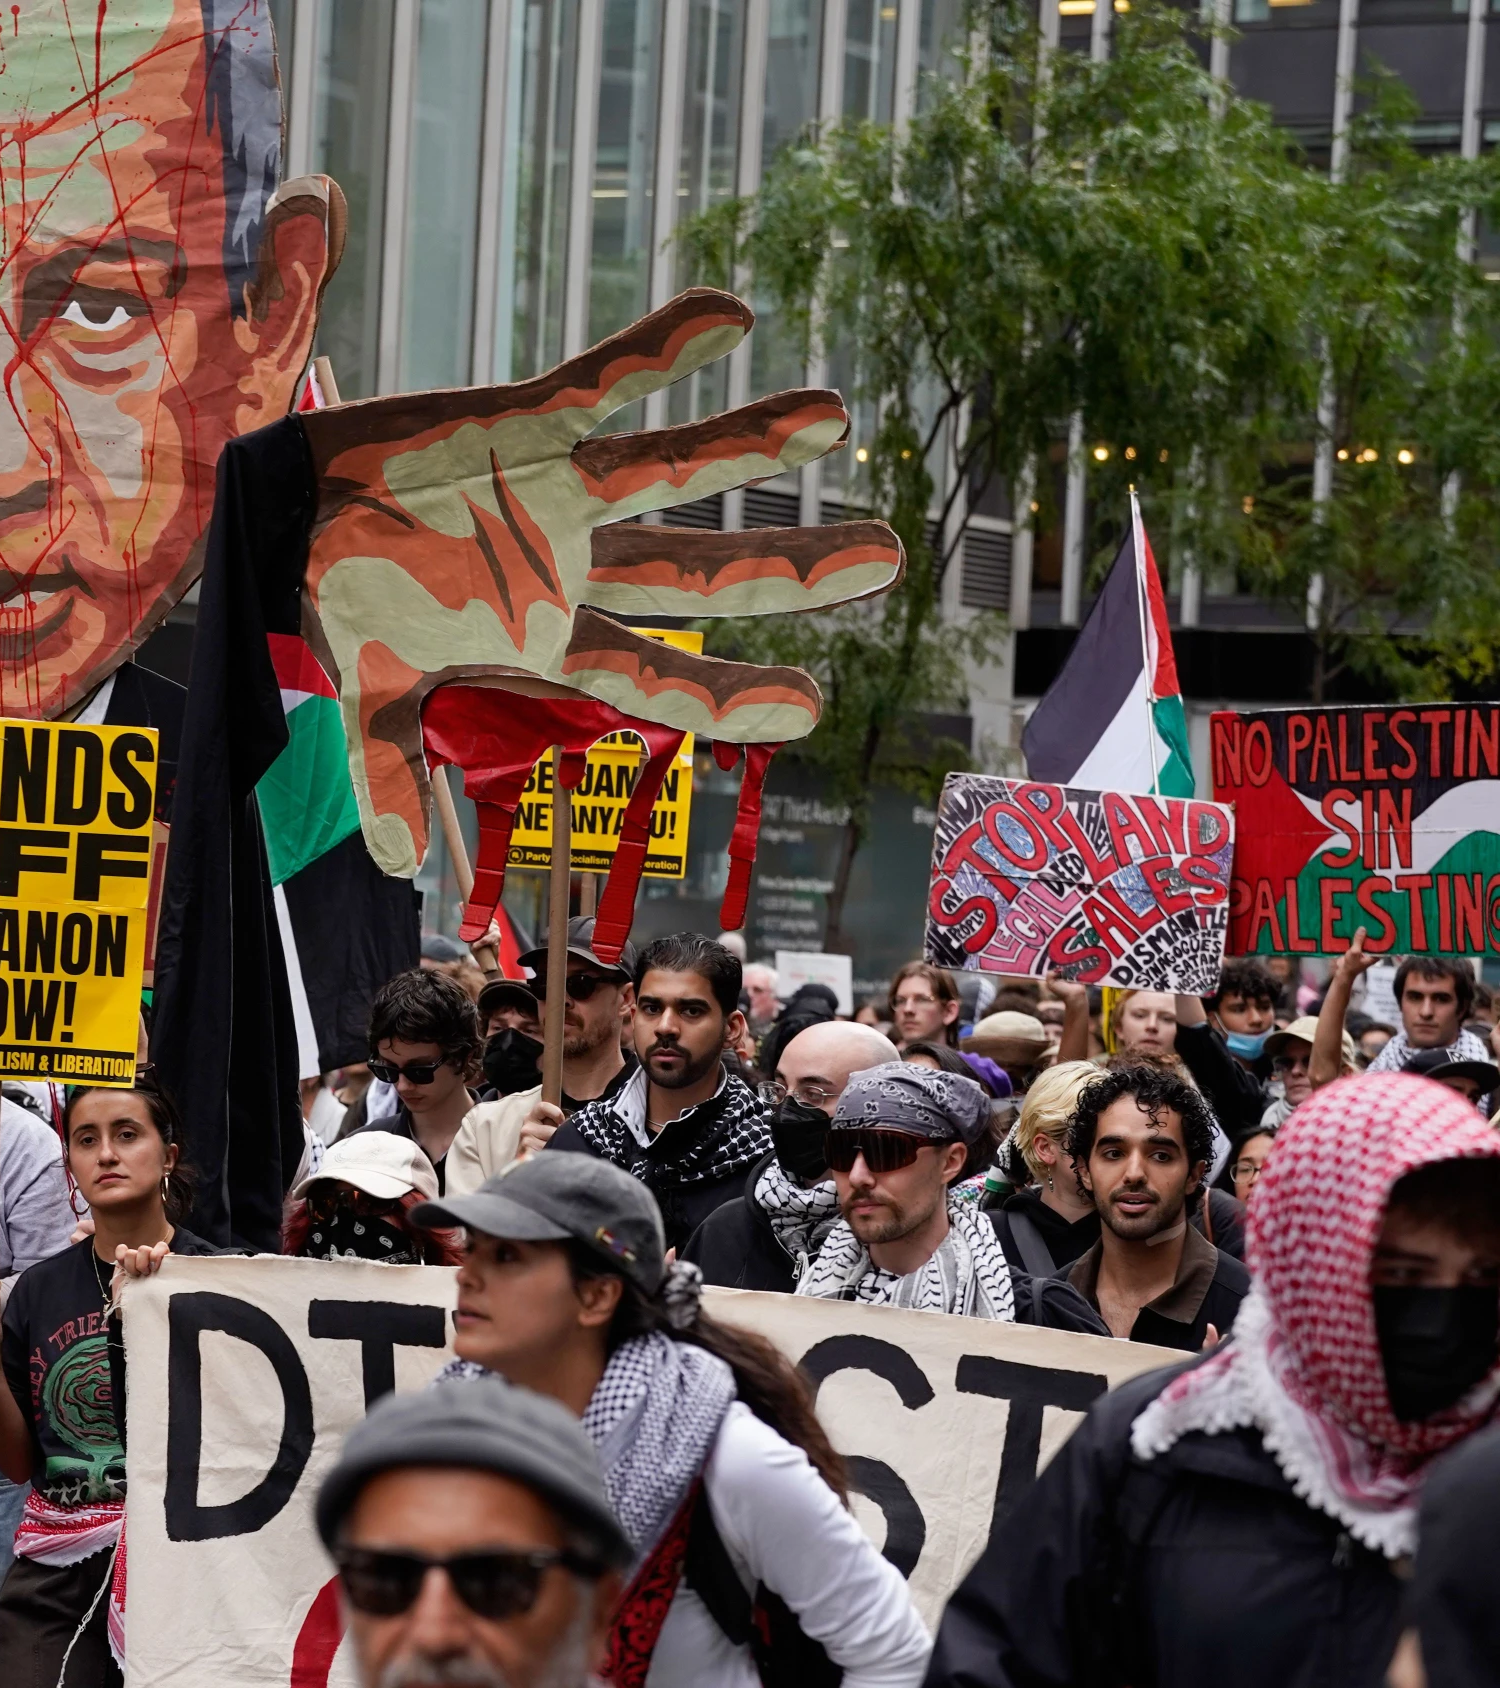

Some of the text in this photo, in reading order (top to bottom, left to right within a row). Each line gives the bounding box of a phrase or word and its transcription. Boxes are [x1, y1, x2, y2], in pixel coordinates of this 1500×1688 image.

[1214, 708, 1500, 787] NO PALESTIN
[526, 852, 551, 863] Party
[643, 861, 679, 871] eration
[929, 780, 1230, 955] STOP LAND
[1321, 788, 1413, 870] SIN
[1048, 856, 1228, 984] SALES
[1110, 906, 1228, 986] DISMANTLE
[1172, 953, 1219, 979] SATAN
[38, 1054, 50, 1071] &
[53, 1055, 134, 1078] LIBERATION
[48, 1311, 110, 1351] TRIE
